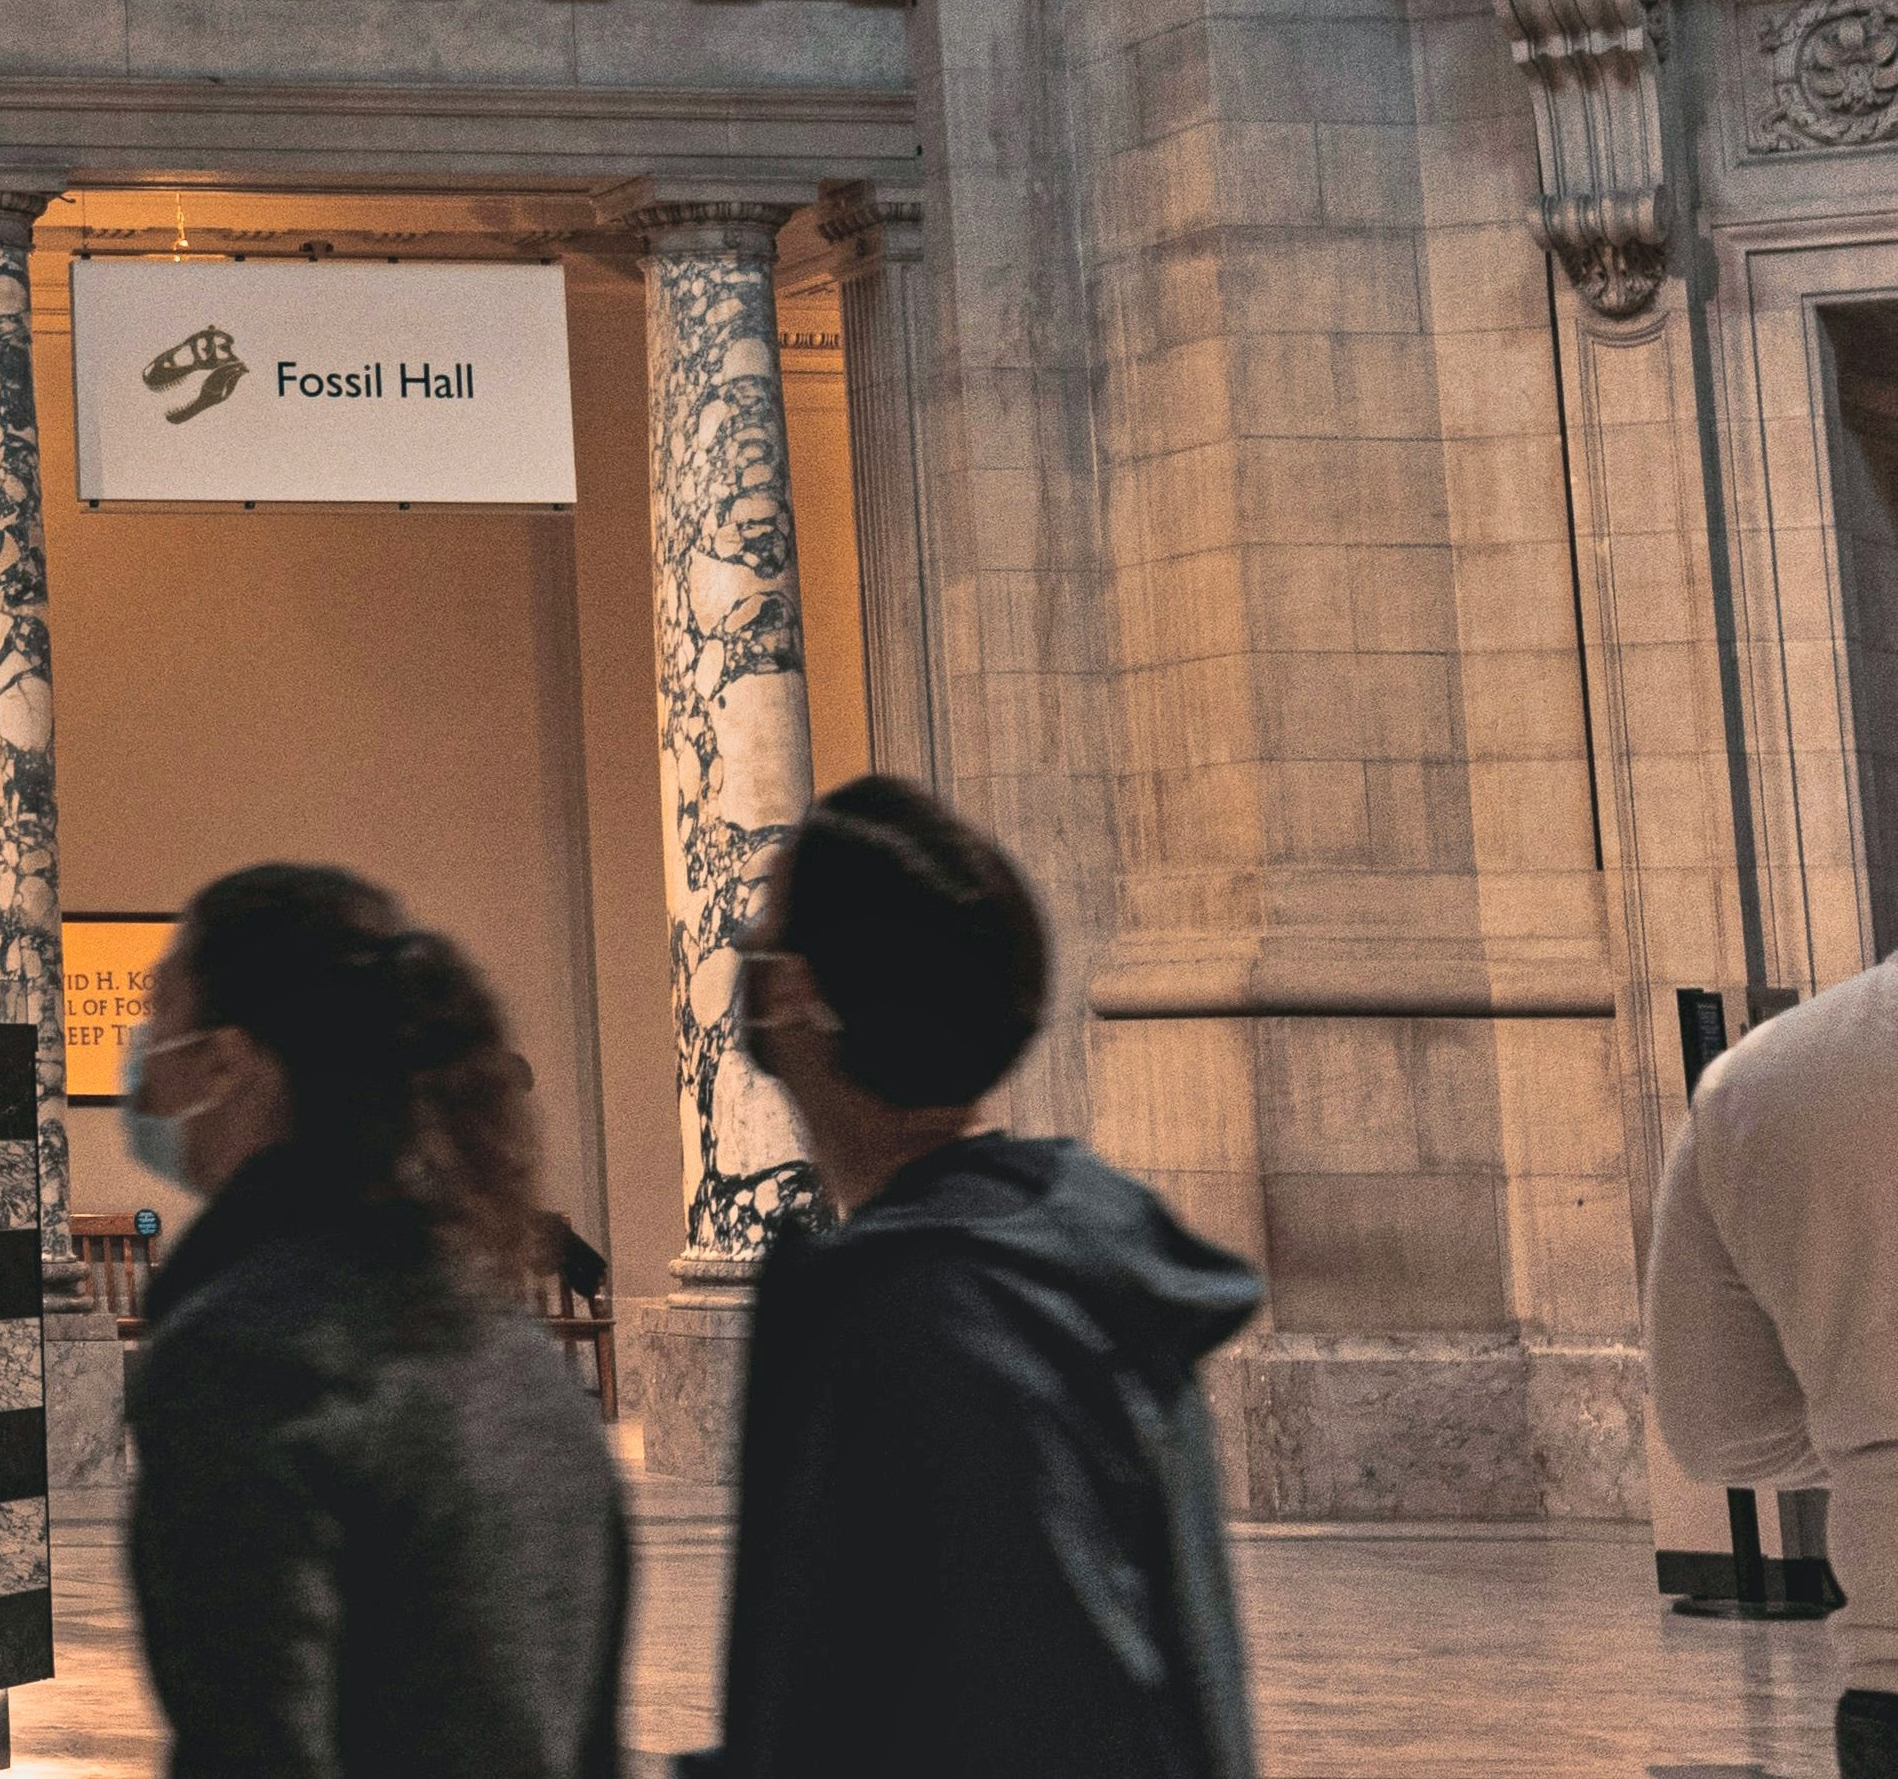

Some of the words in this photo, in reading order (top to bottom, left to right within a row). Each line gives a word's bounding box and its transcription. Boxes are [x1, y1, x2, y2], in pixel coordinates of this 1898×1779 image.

[277, 361, 383, 399] Fossil
[400, 363, 474, 399] Hall
[96, 971, 120, 991] H.
[127, 971, 155, 991] KO
[83, 999, 108, 1016] OF
[114, 997, 152, 1016] FOS
[67, 1026, 104, 1046] EEP
